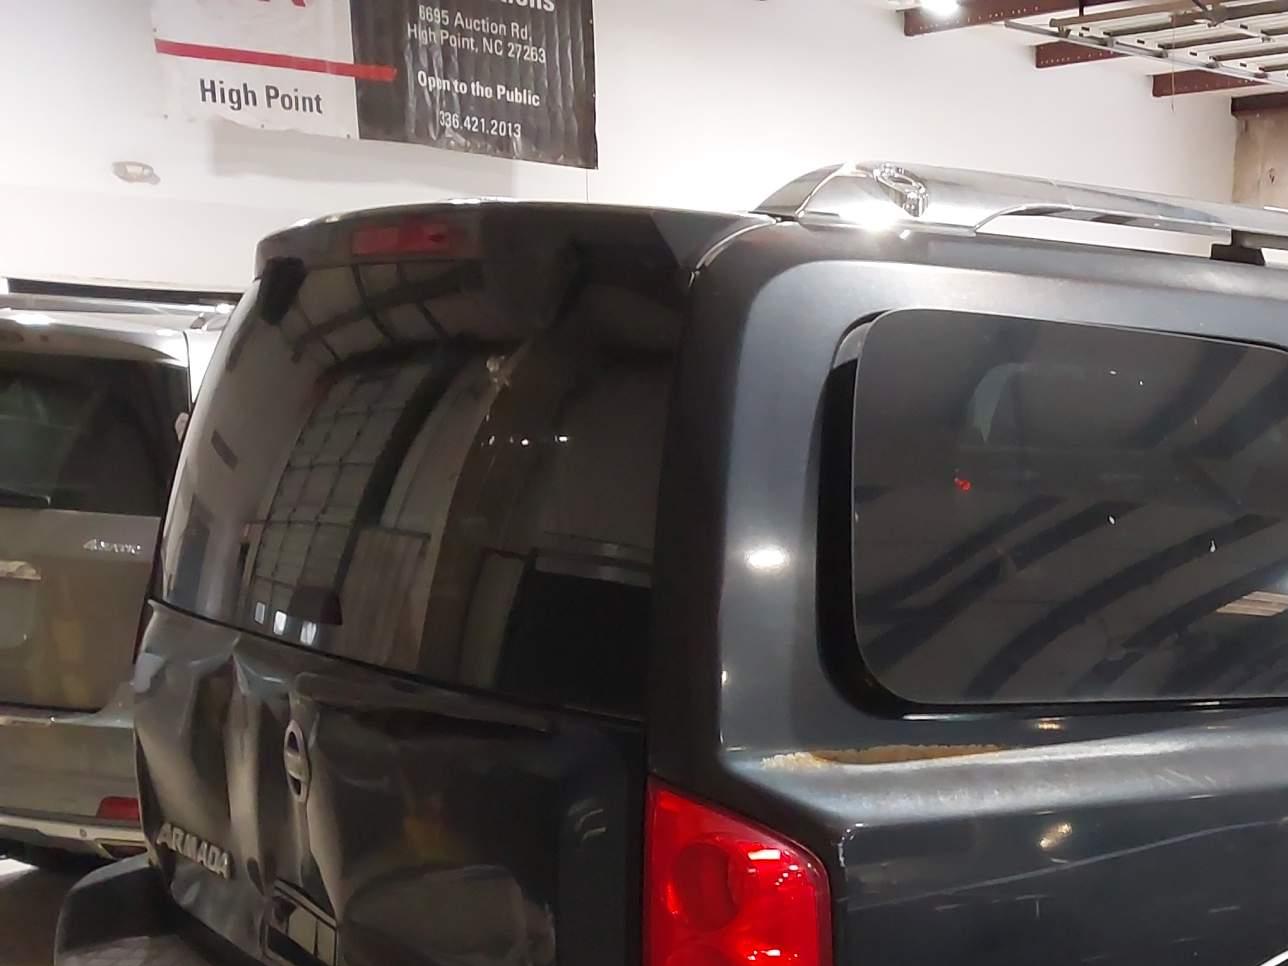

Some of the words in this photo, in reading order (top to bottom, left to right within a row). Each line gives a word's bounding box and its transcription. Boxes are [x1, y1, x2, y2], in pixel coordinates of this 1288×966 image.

[418, 4, 450, 26] 6695
[453, 11, 507, 36] Auction
[407, 22, 437, 46] High
[440, 29, 479, 54] Point,
[482, 37, 504, 56] NC
[507, 42, 547, 64] 27263
[199, 78, 257, 111] High
[264, 84, 323, 114] Point
[417, 70, 450, 92] Open
[453, 79, 468, 95] to
[470, 81, 493, 99] the
[496, 84, 541, 107] Public
[439, 109, 522, 139] 336.421.2013
[156, 822, 229, 879] ARMADA
